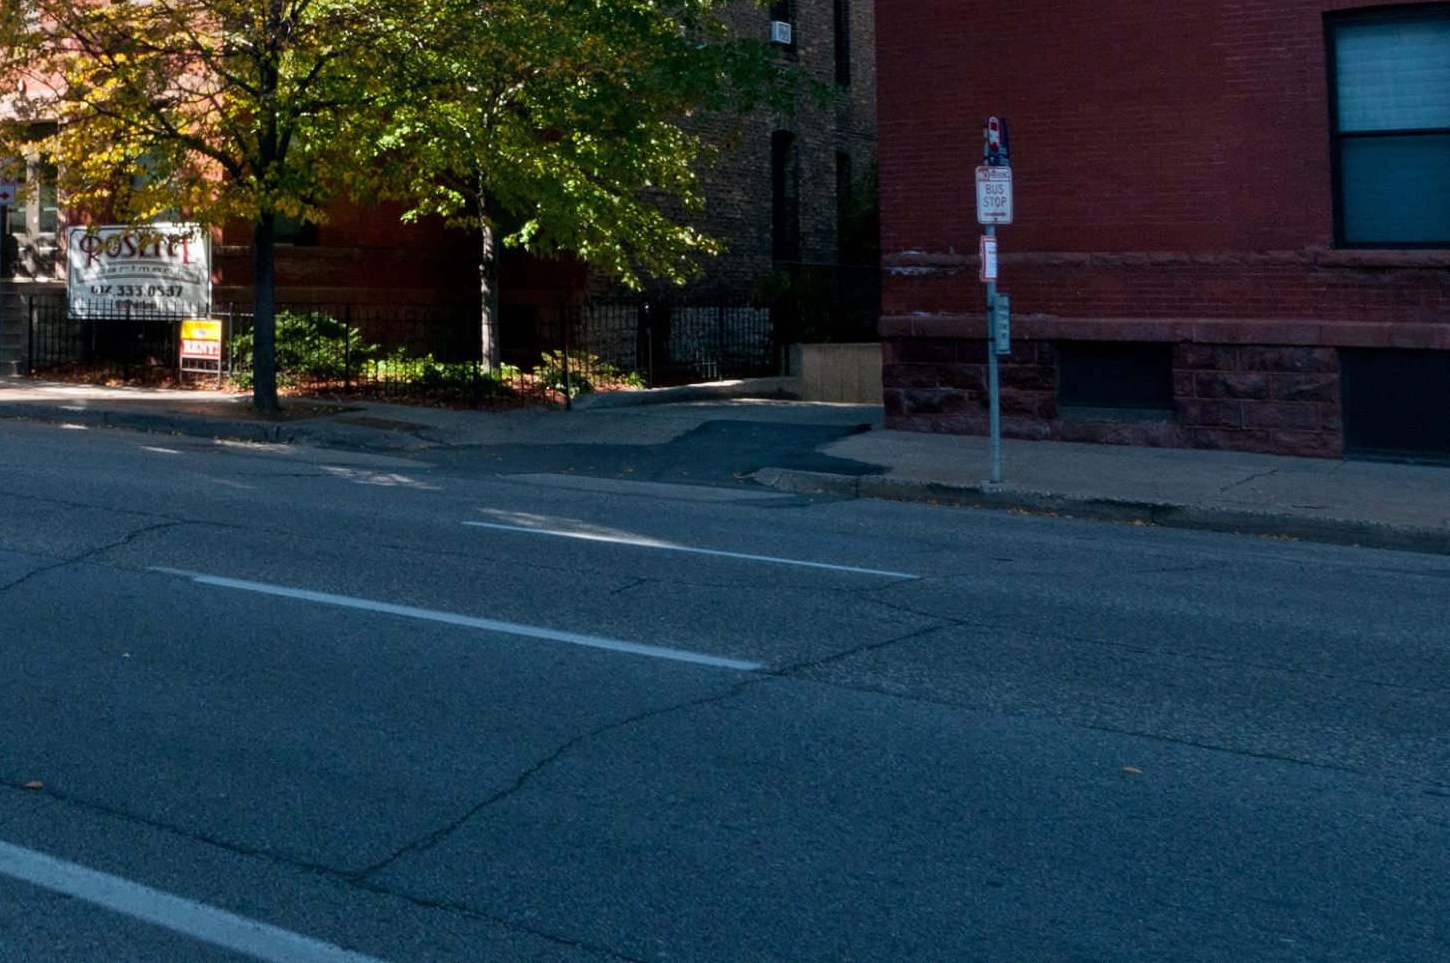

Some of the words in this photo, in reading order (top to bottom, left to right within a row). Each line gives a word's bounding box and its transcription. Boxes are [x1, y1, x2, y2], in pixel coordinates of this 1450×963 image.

[985, 184, 1004, 195] BUS
[983, 197, 1007, 207] STOP
[85, 265, 195, 278] partments
[183, 340, 219, 355] RENT!
